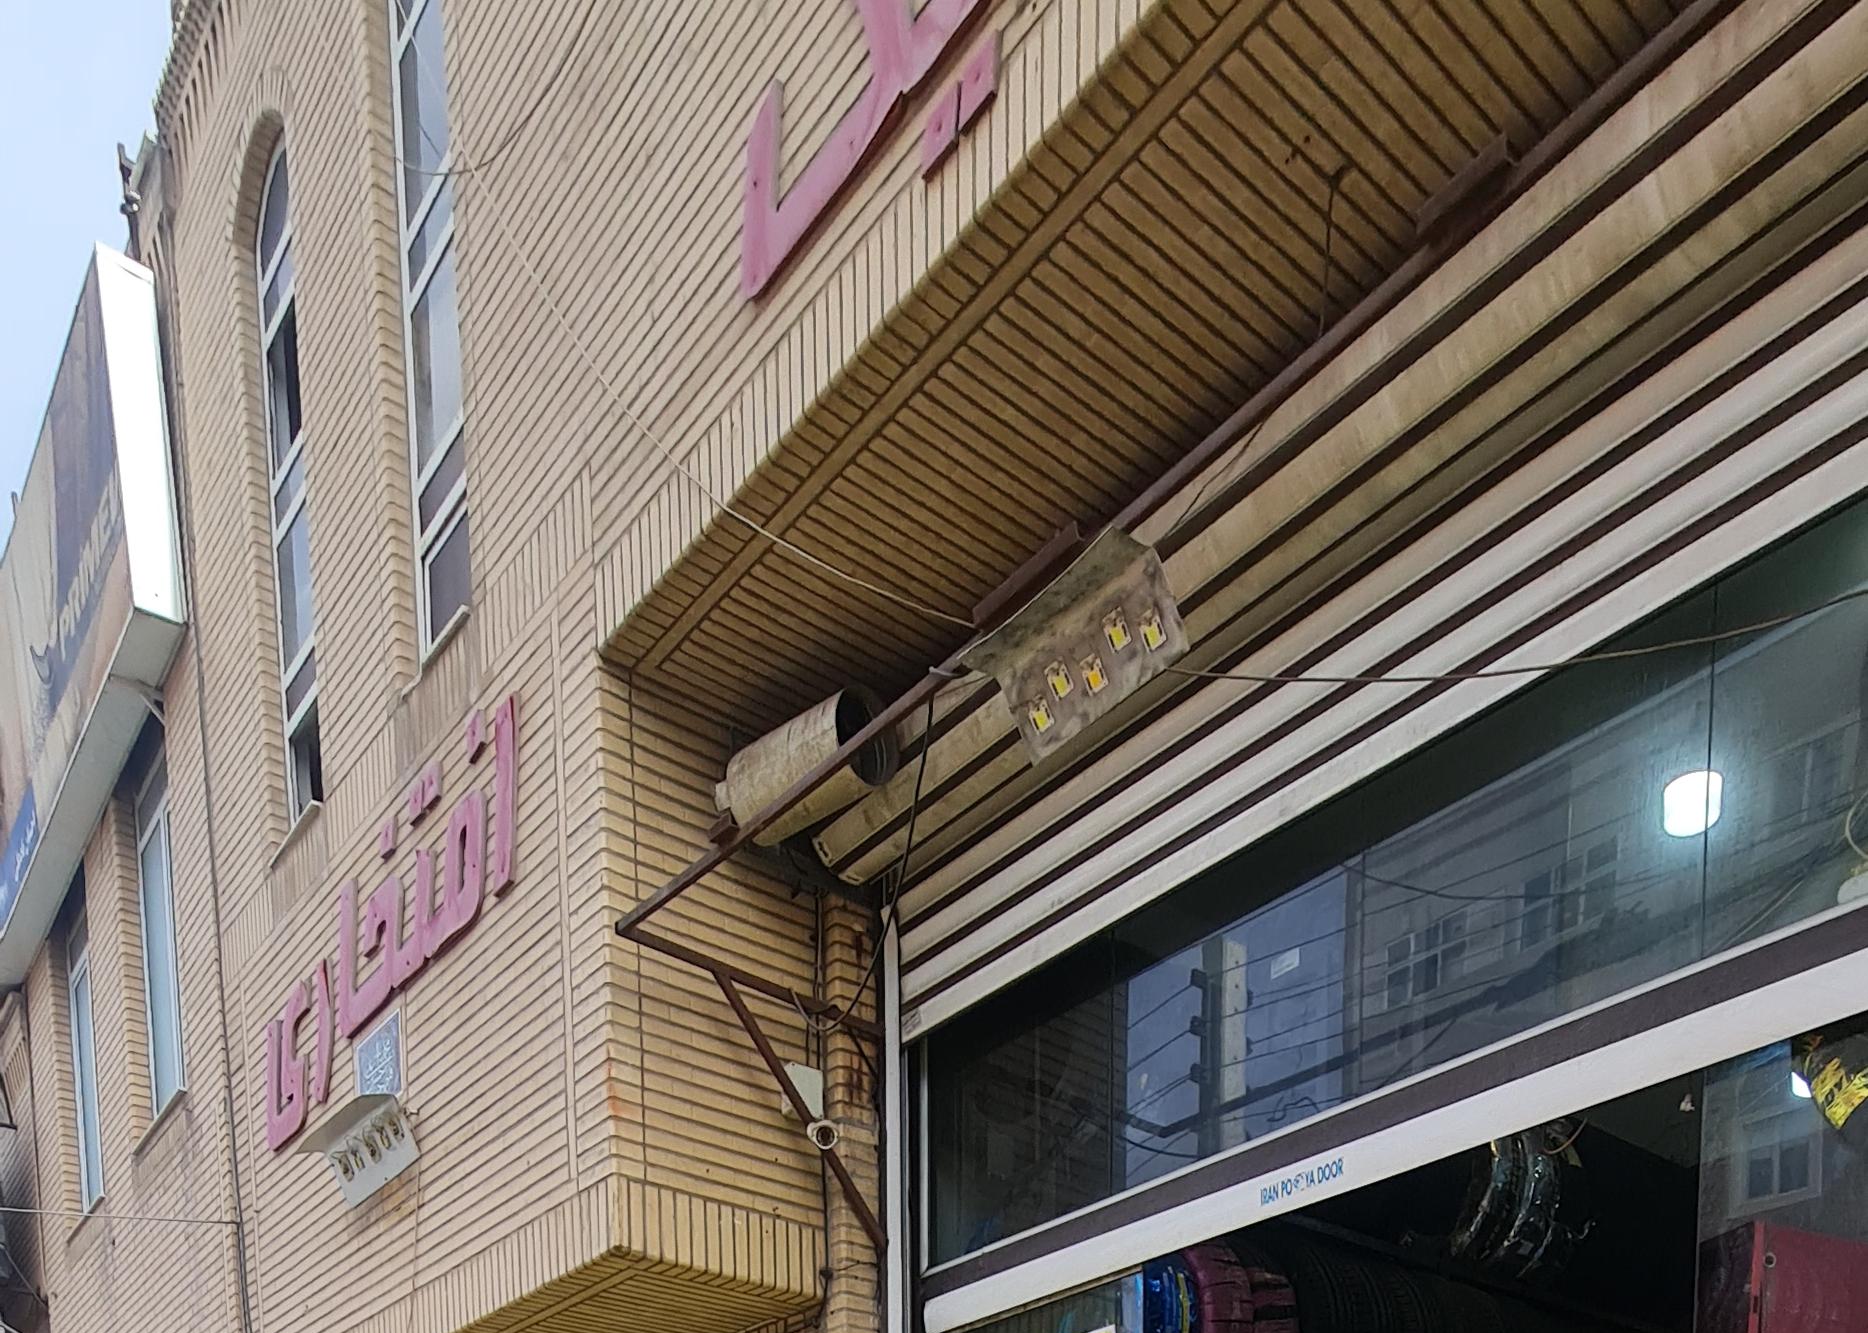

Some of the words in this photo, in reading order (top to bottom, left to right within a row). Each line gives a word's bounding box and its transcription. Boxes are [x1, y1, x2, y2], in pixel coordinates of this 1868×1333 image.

[1260, 1183, 1279, 1206] IRAN
[1281, 1170, 1315, 1198] POYA
[1317, 1158, 1344, 1184] DOOR
